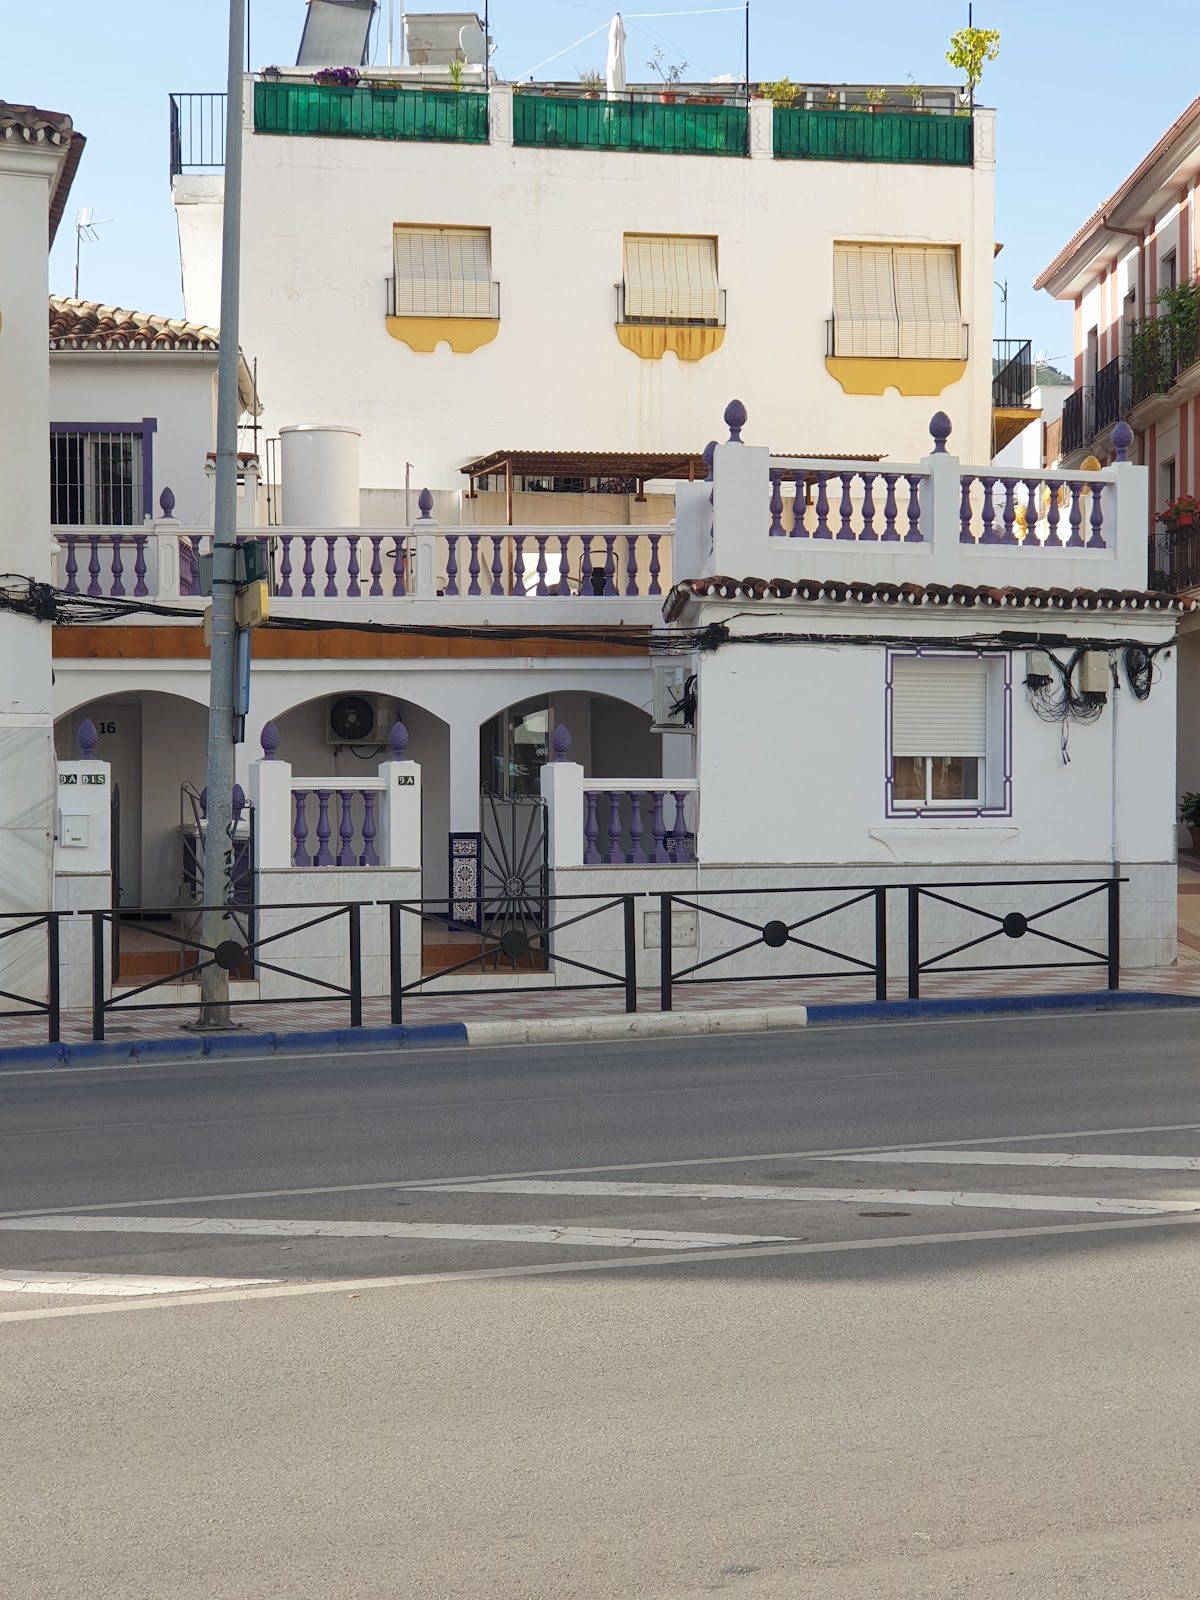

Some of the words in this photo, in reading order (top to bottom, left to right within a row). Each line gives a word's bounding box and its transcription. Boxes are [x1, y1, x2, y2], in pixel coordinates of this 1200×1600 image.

[100, 722, 116, 734] 16
[60, 775, 77, 784] 9A
[82, 775, 105, 784] BIS
[398, 776, 414, 785] 9A
